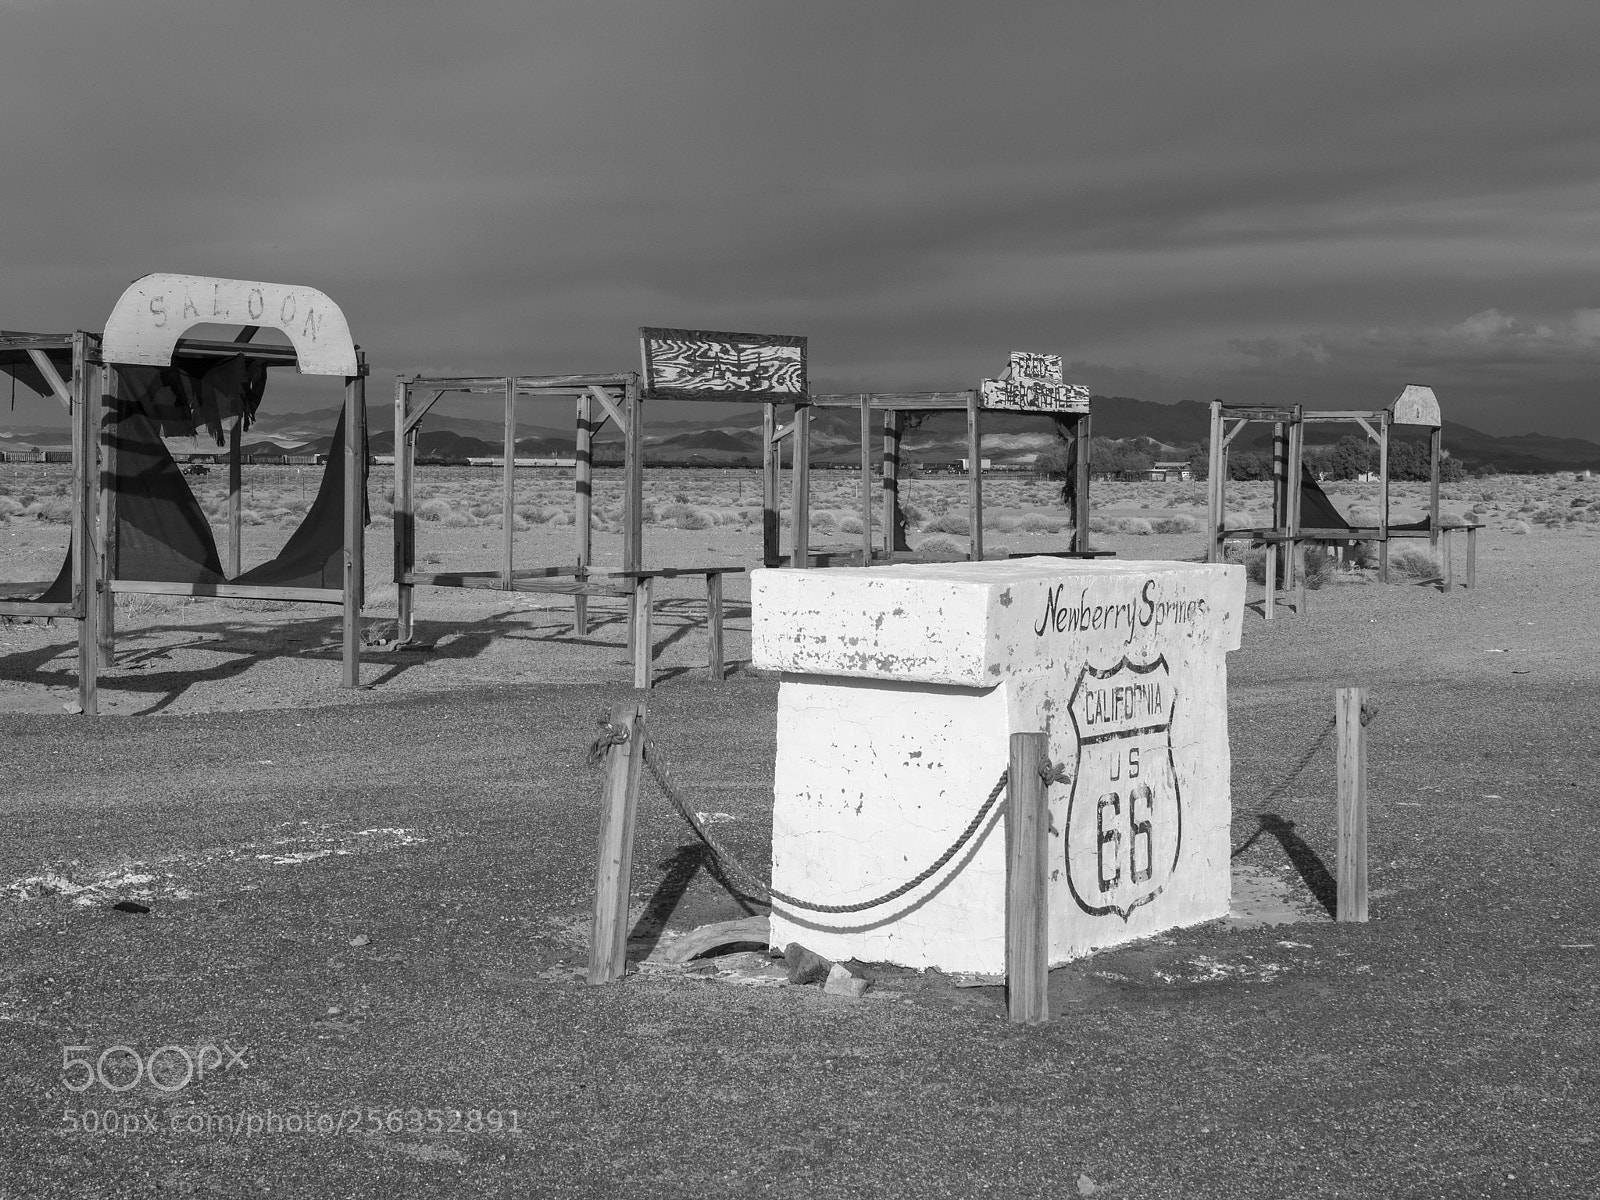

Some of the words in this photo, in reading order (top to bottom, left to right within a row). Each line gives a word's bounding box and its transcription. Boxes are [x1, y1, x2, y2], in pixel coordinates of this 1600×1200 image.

[149, 283, 324, 342] SALOON
[1034, 583, 1137, 646] Newberry
[1096, 785, 1154, 894] 66
